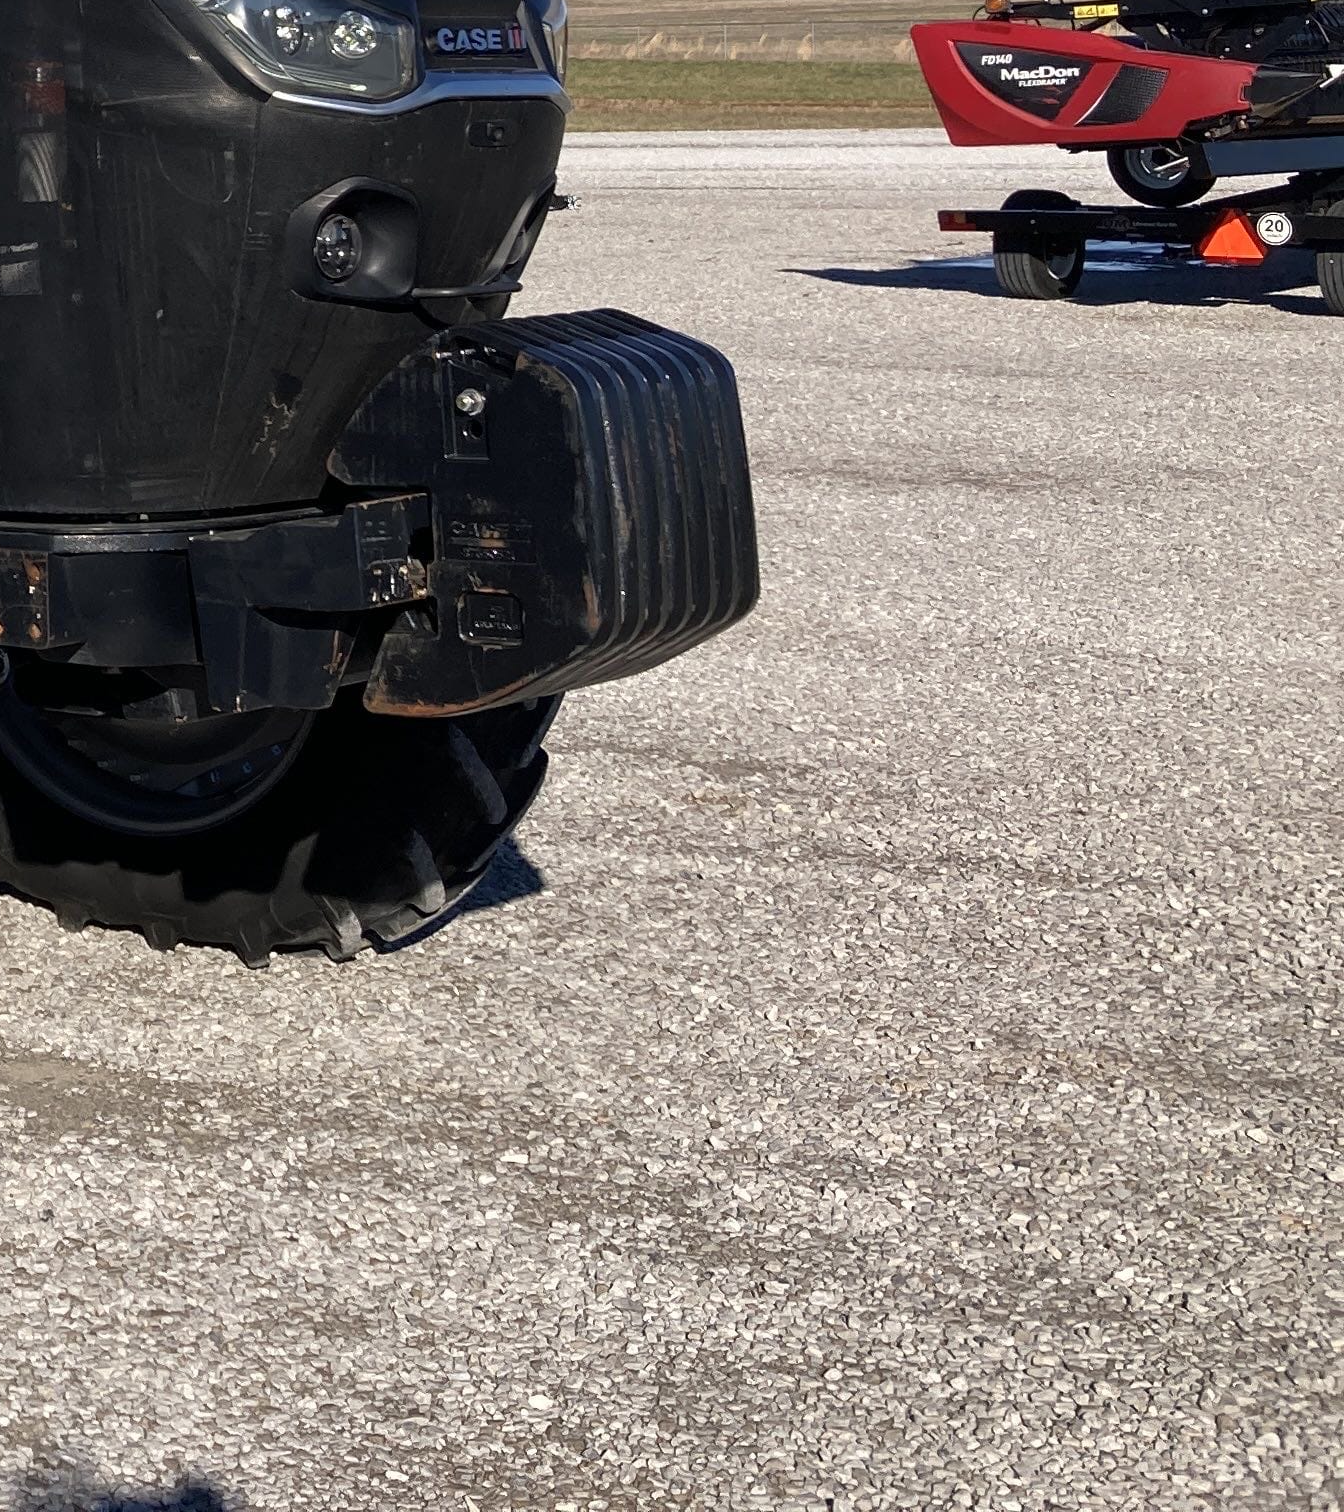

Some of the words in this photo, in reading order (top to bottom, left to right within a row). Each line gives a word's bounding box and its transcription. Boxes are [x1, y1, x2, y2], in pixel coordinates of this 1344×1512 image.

[437, 27, 503, 52] CASE
[981, 53, 1013, 66] FD140
[1000, 65, 1080, 81] MacDon
[1264, 219, 1284, 232] 20
